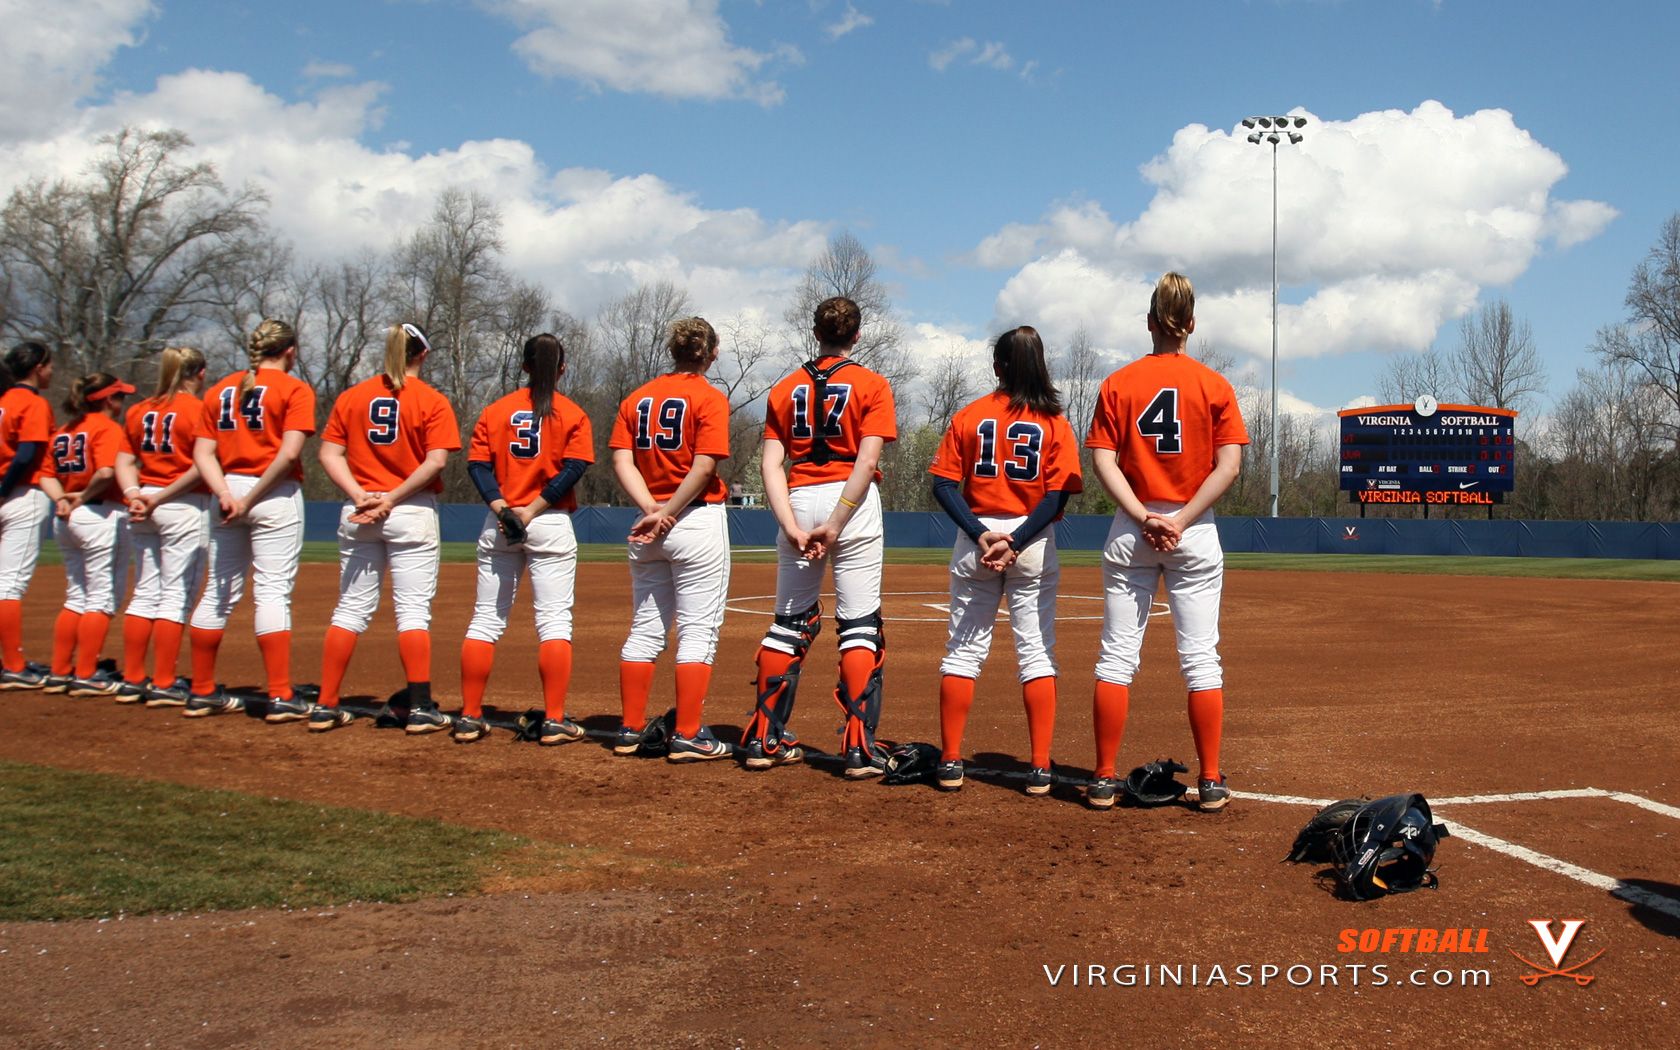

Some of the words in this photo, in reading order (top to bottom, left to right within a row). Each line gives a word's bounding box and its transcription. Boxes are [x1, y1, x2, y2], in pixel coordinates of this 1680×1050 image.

[217, 386, 268, 431] 14
[368, 396, 400, 445] 9
[635, 397, 687, 451] 19
[791, 383, 852, 438] 17
[1136, 387, 1182, 454] 4
[1358, 416, 1412, 426] VIRGINIA
[1441, 416, 1499, 426] SOFTBALL
[53, 432, 88, 474] 23
[140, 411, 177, 454] 11
[509, 410, 542, 459] 3
[974, 418, 1045, 482] 13
[1393, 428, 1397, 436] 1
[1401, 428, 1405, 436] 2
[1409, 428, 1413, 436] 3
[1417, 428, 1422, 436] 4
[1426, 428, 1430, 436] 5
[1441, 428, 1446, 436] 7
[1465, 428, 1473, 436] 10
[1342, 465, 1353, 473] AVG
[1378, 465, 1386, 473] AT
[1419, 465, 1433, 473] BALL
[1448, 465, 1468, 473] STRIKE
[1488, 465, 1500, 473] OUT
[1358, 491, 1421, 503] VIRGINIA
[1426, 491, 1493, 503] SOFTBALL
